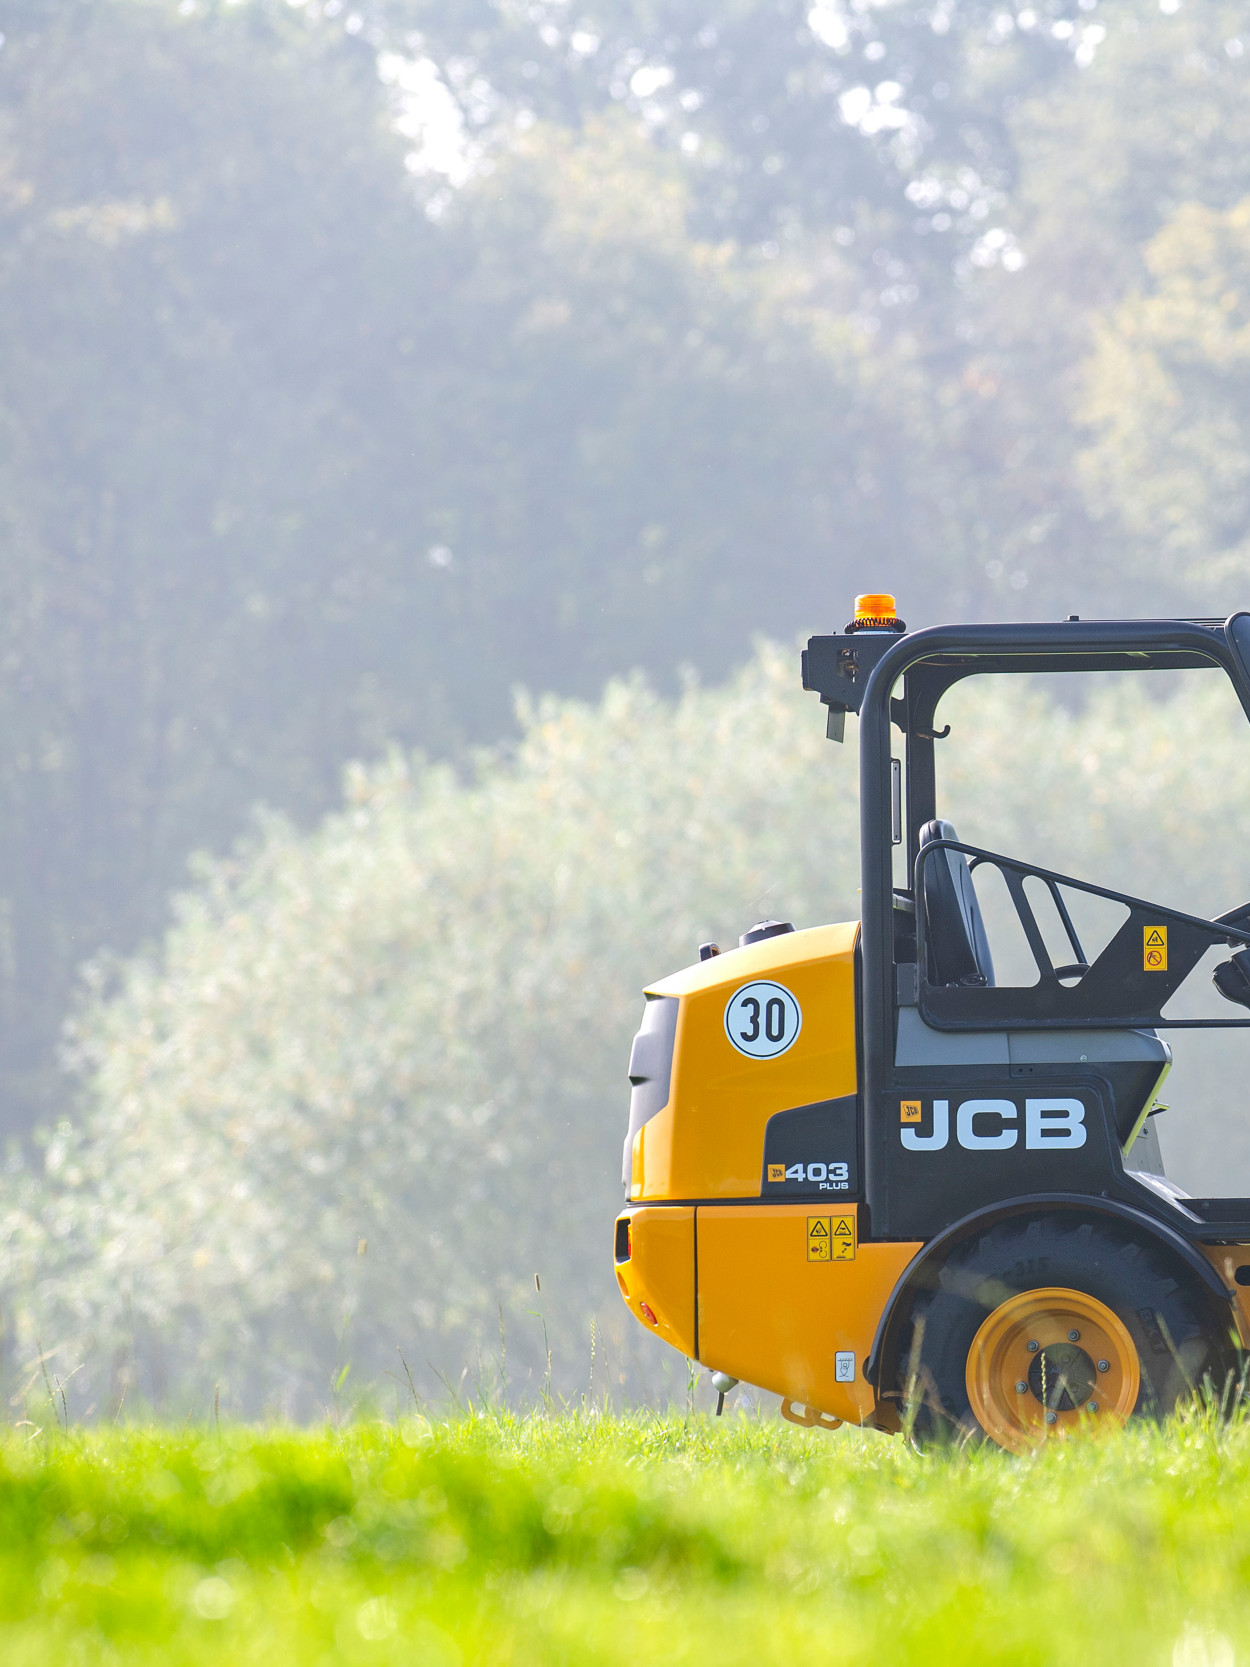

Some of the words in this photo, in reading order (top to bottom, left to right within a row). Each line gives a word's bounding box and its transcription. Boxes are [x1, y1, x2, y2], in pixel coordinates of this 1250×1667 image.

[740, 996, 786, 1043] 30
[900, 1098, 1088, 1151] JCB
[785, 1162, 849, 1182] 403
[819, 1182, 849, 1190] PLUS
